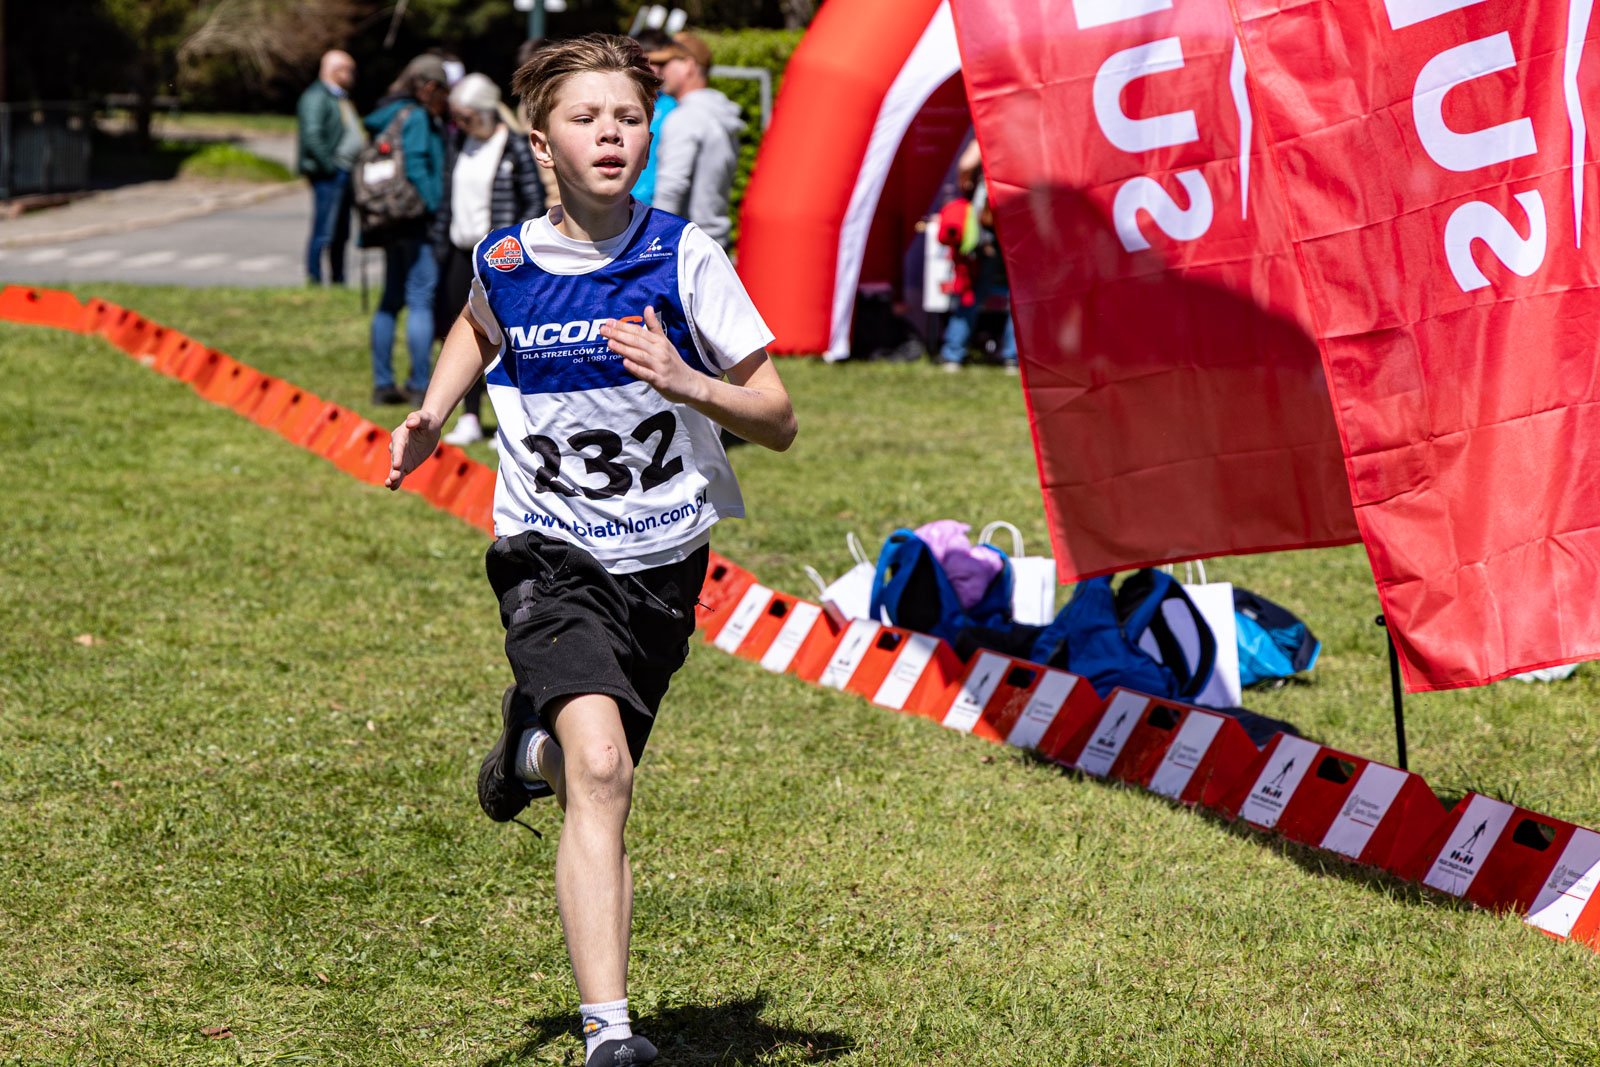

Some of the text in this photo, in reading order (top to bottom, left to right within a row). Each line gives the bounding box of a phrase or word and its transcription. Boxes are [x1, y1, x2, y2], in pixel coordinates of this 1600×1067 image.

[541, 347, 596, 358] STRZELCÓW
[587, 354, 607, 362] 1989
[608, 353, 624, 361] rok
[521, 410, 684, 500] 232
